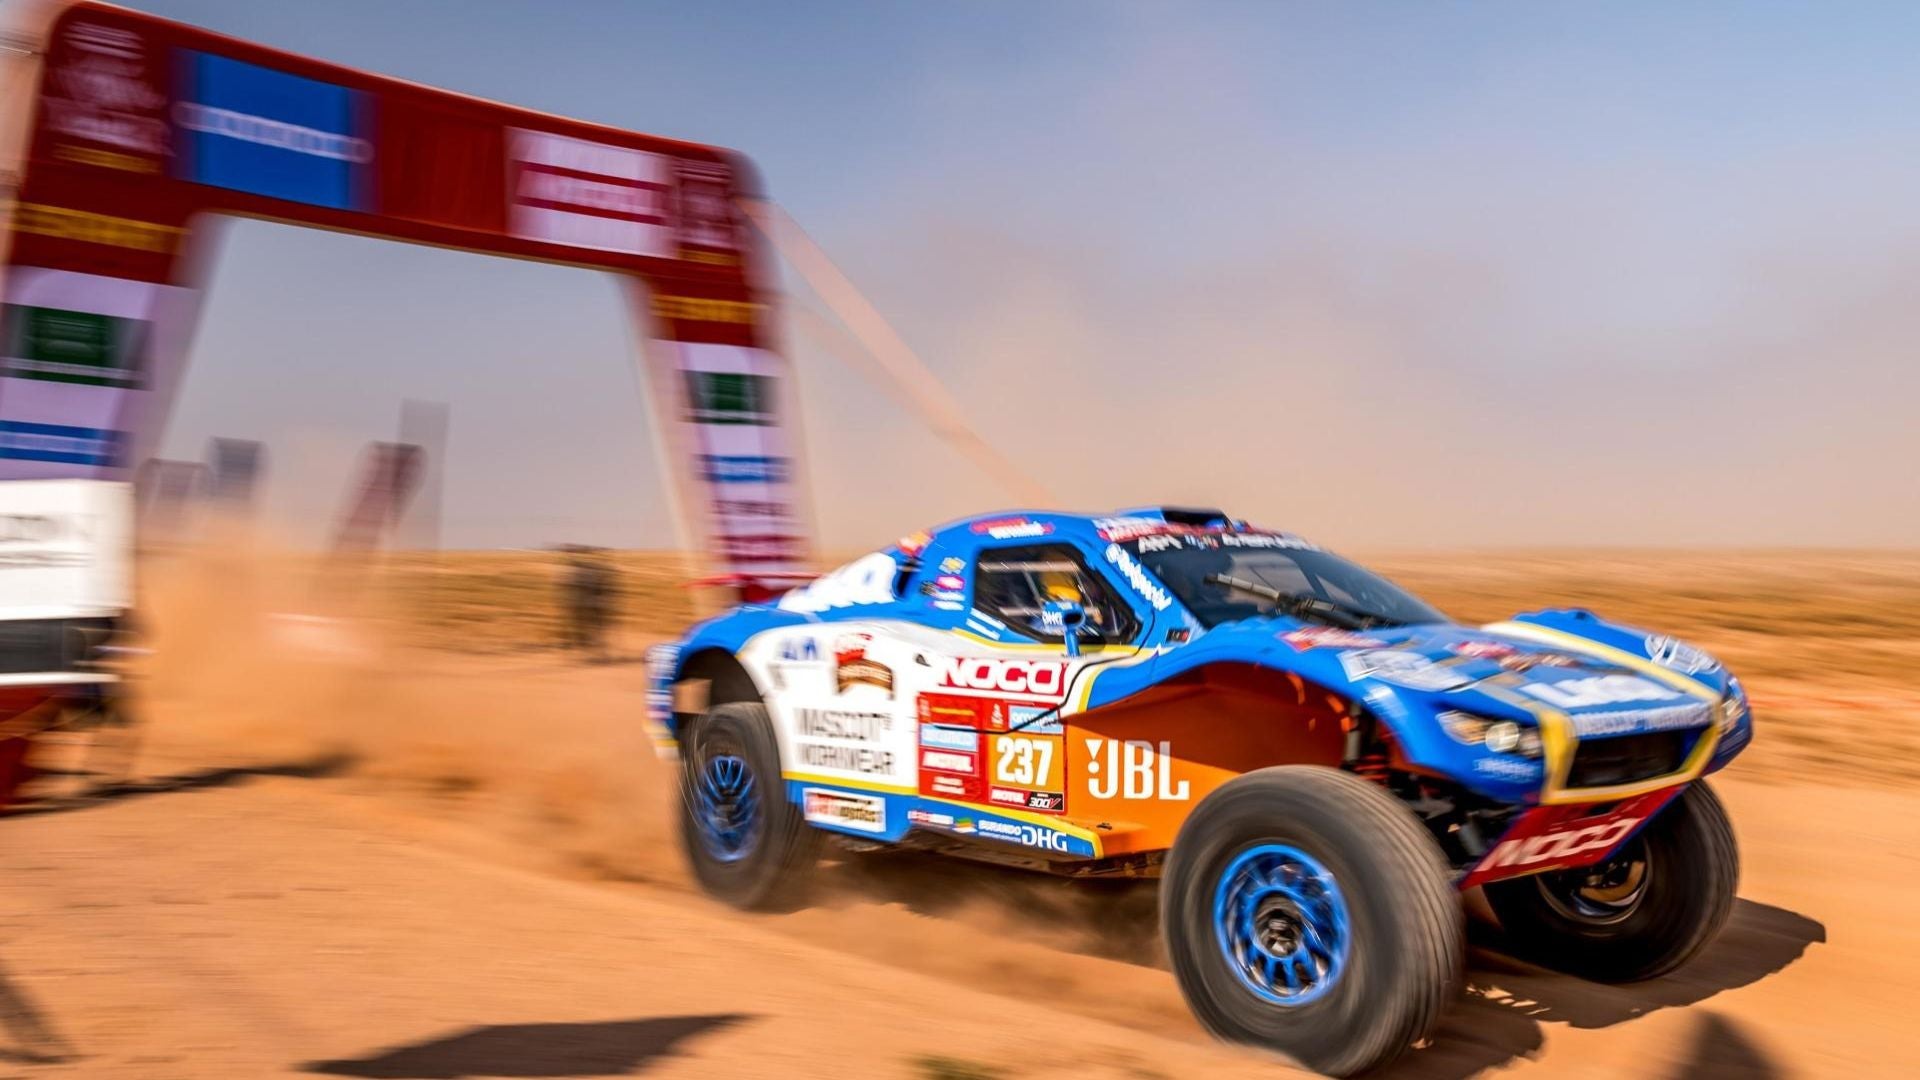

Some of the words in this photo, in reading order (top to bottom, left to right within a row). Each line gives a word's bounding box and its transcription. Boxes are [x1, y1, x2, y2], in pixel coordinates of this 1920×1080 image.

[938, 657, 1060, 693] NOCO
[996, 737, 1053, 786] 237
[1085, 738, 1190, 800] JBL
[1021, 825, 1068, 852] DHG
[1474, 817, 1642, 872] NOCO
